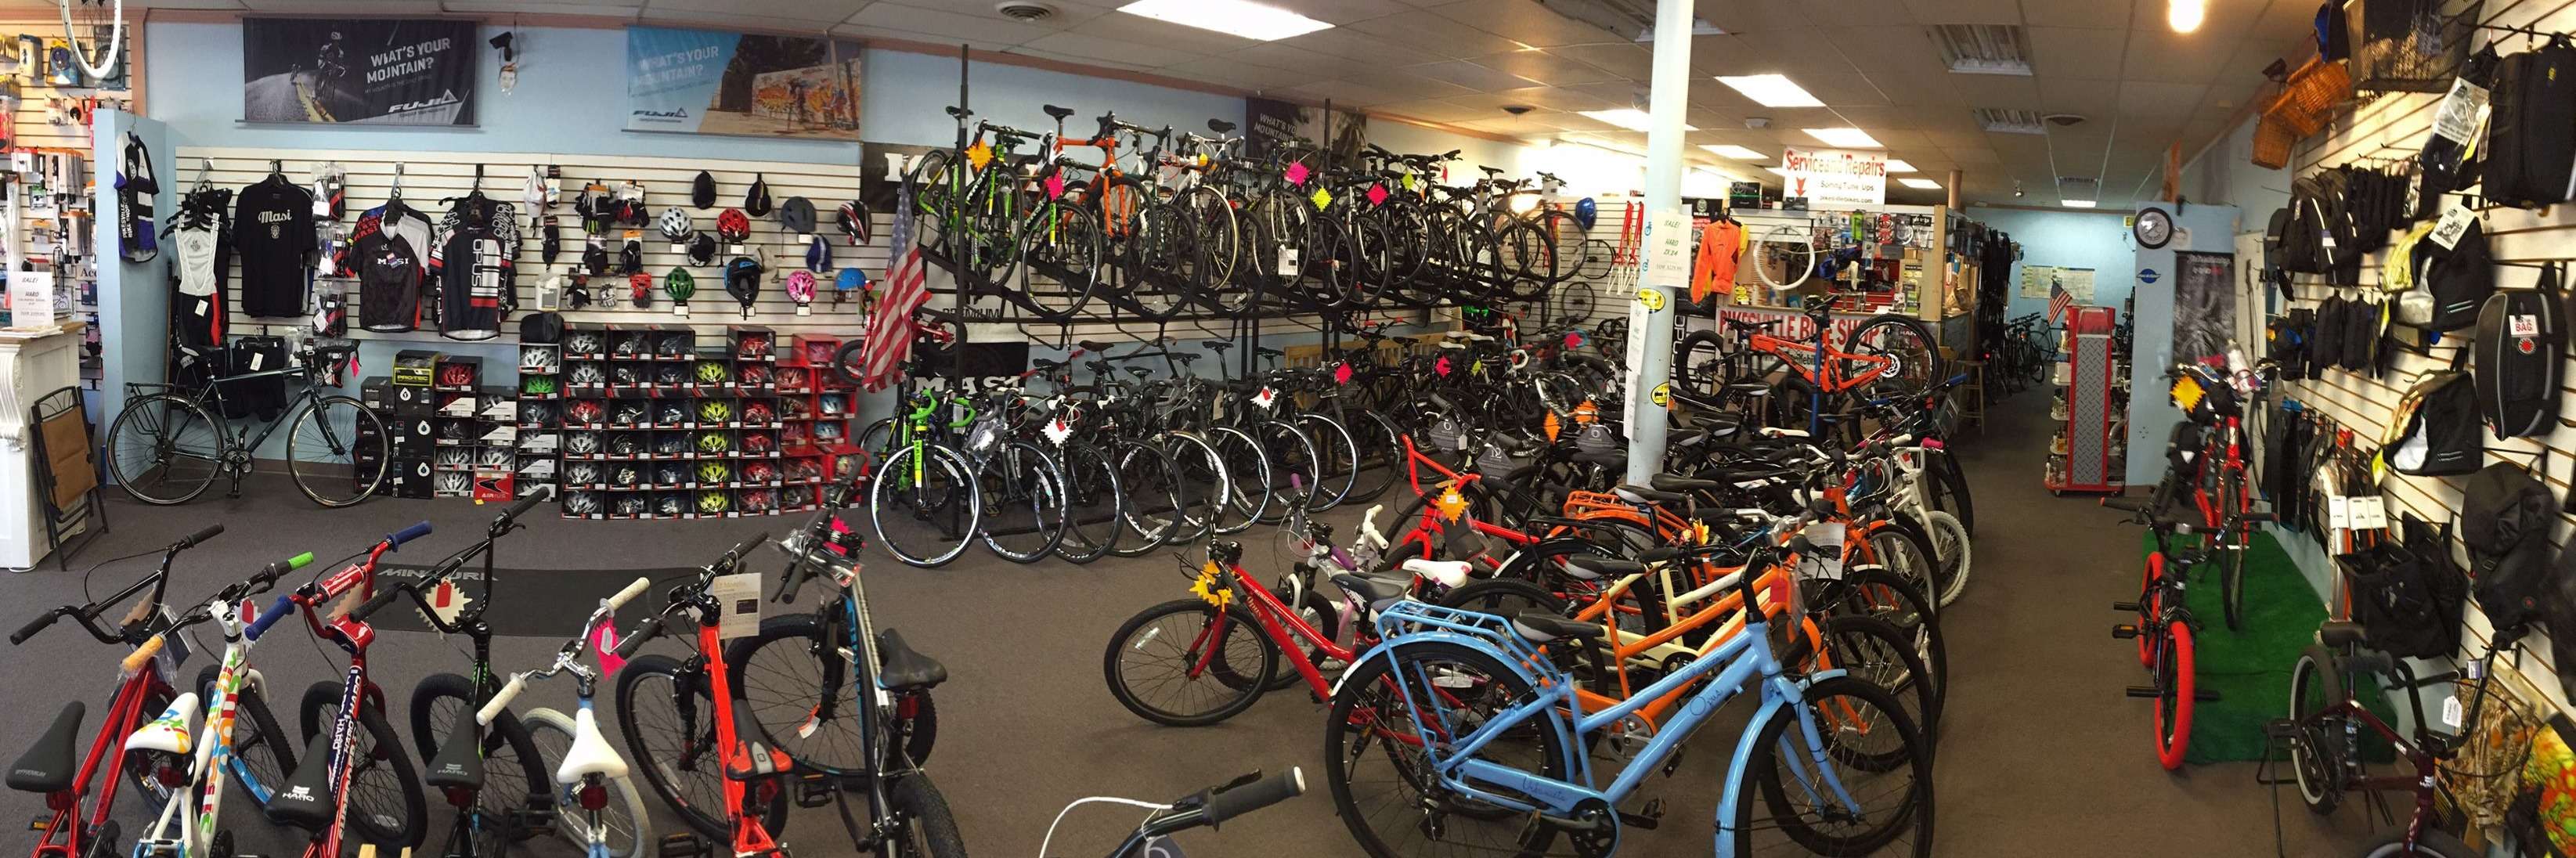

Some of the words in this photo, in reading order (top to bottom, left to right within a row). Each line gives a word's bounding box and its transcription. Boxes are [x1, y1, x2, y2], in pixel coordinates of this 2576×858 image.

[417, 37, 451, 56] YOUR
[686, 45, 720, 63] YOUR
[388, 97, 444, 113] FUJI
[1259, 112, 1286, 131] WHAT'S
[1785, 150, 1823, 172] Service
[1845, 154, 1885, 178] Repairs
[1861, 183, 1874, 192] Ups
[258, 208, 293, 224] Masi
[471, 238, 484, 287] OPUS
[2515, 323, 2533, 332] BAG
[1690, 690, 1723, 716] Opus
[332, 718, 346, 751] HARO
[282, 791, 315, 802] HARO
